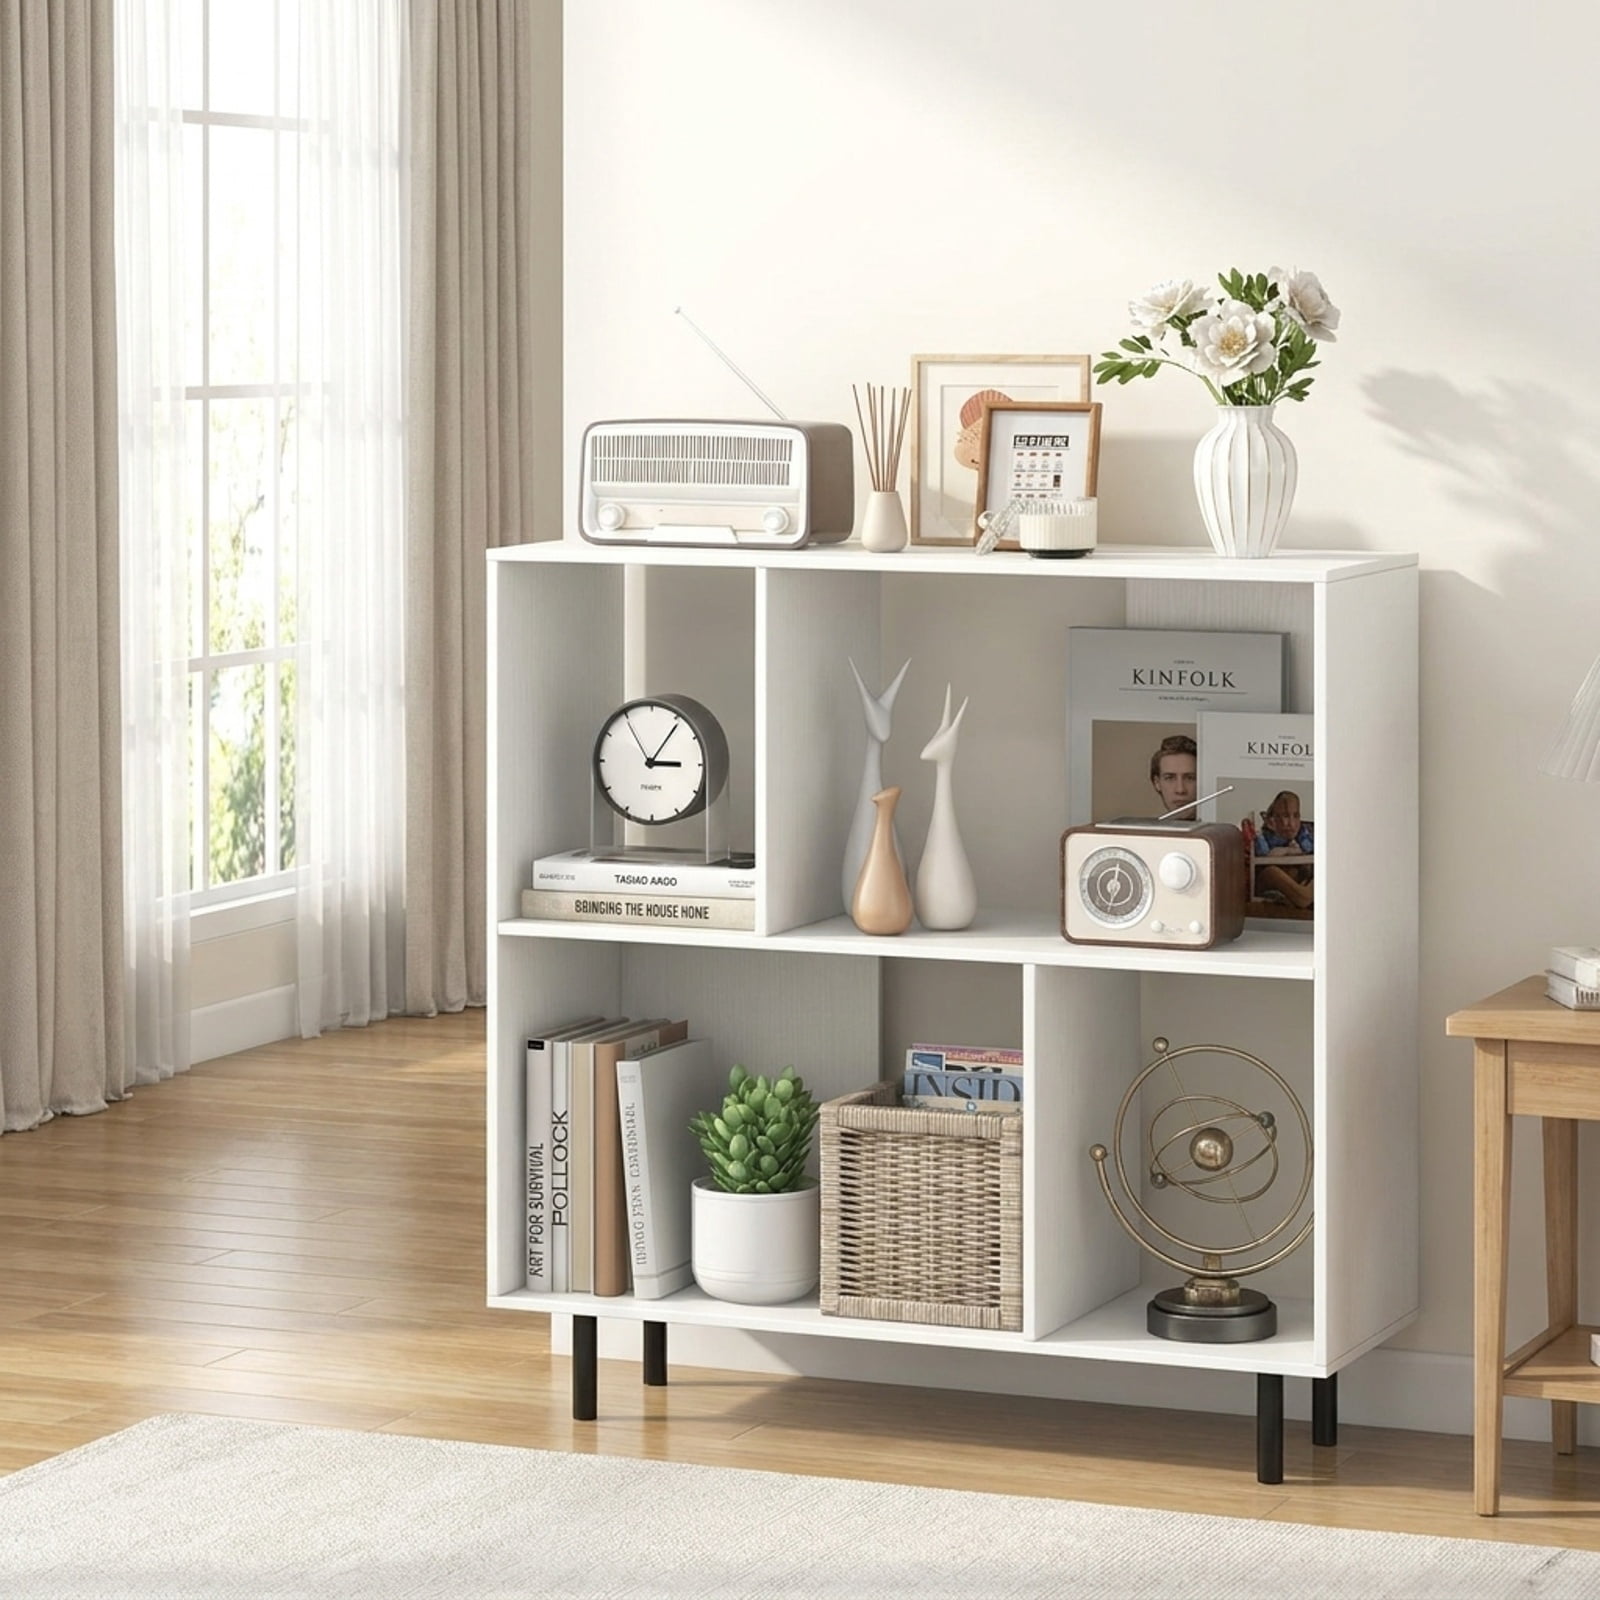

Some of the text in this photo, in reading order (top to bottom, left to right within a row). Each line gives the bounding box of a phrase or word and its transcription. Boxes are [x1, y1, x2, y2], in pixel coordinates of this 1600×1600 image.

[1132, 667, 1236, 689] KINFOLK
[1247, 741, 1314, 756] KINFOL
[624, 902, 644, 917] THE
[645, 903, 679, 918] HOUSE
[912, 1072, 1021, 1102] INSID
[551, 1110, 568, 1226] POLLOCK
[528, 1247, 544, 1278] ART
